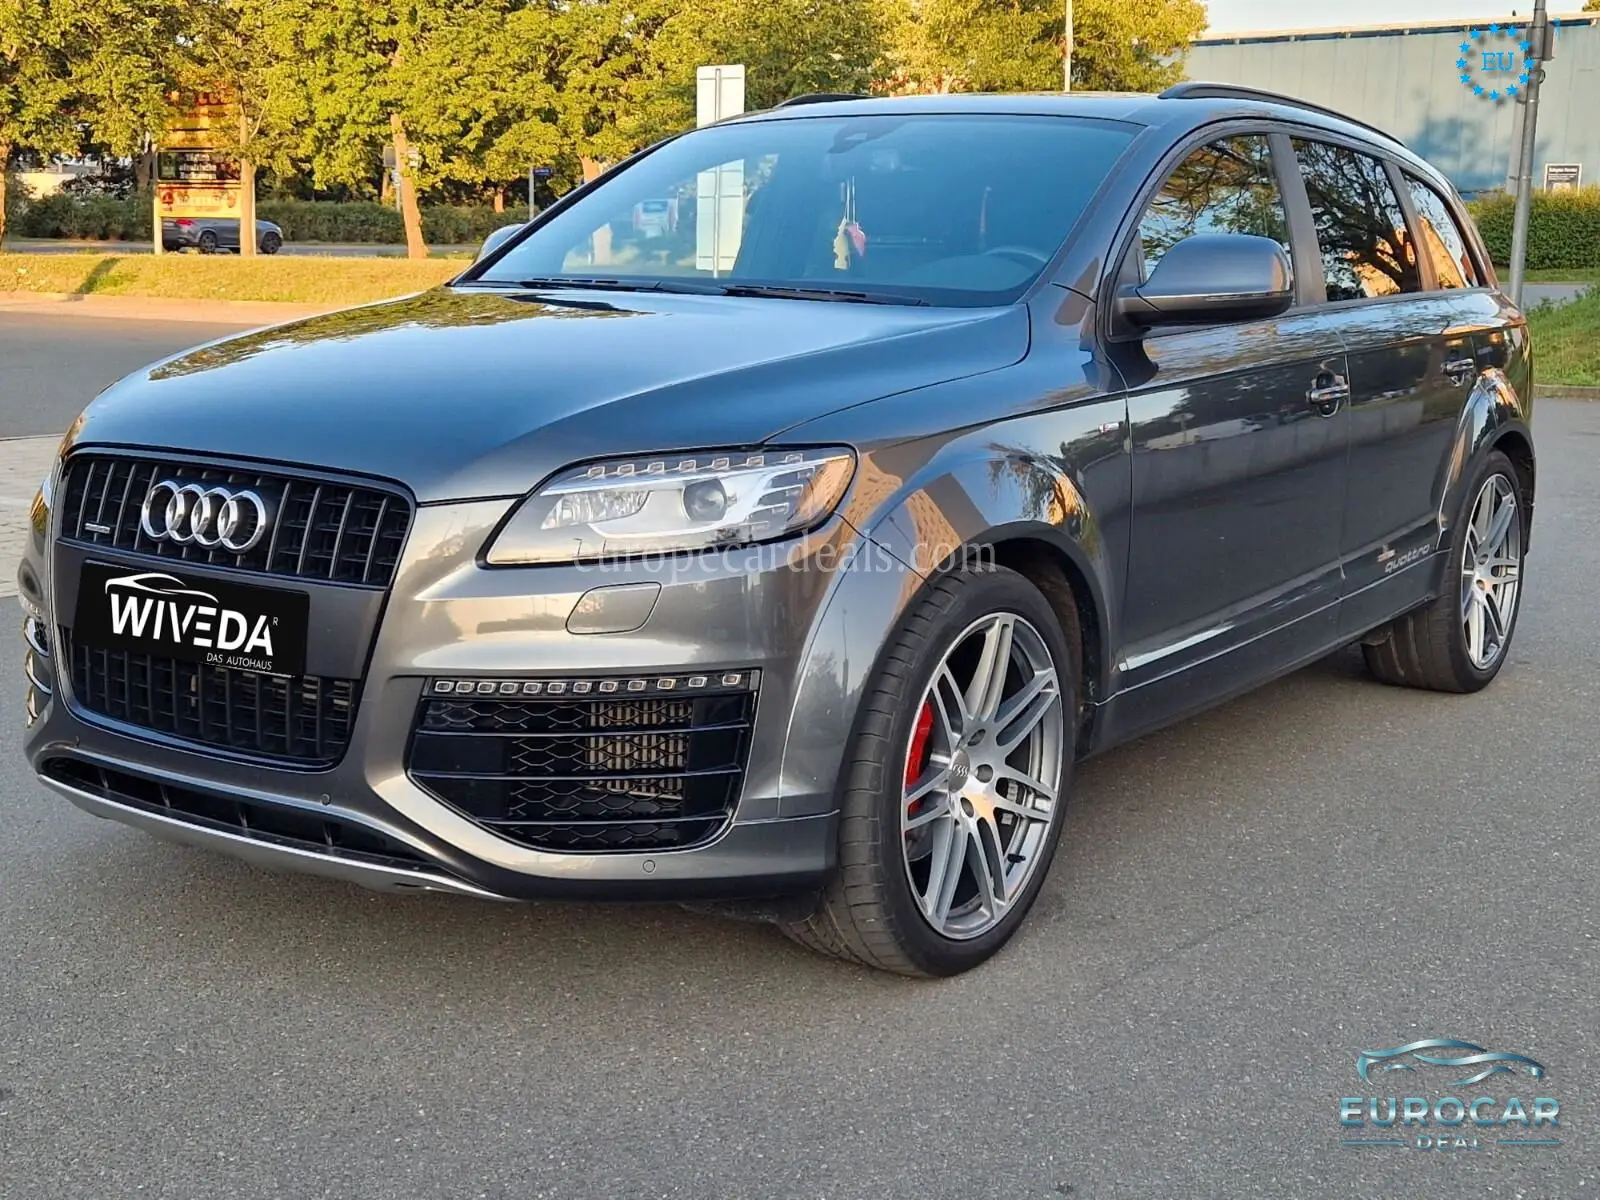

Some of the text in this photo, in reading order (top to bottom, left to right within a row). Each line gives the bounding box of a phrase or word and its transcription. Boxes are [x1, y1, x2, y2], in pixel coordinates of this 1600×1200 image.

[1384, 543, 1431, 573] quattro
[110, 593, 274, 656] WIVEDA
[206, 652, 273, 671] DAS AUTOHAUS
